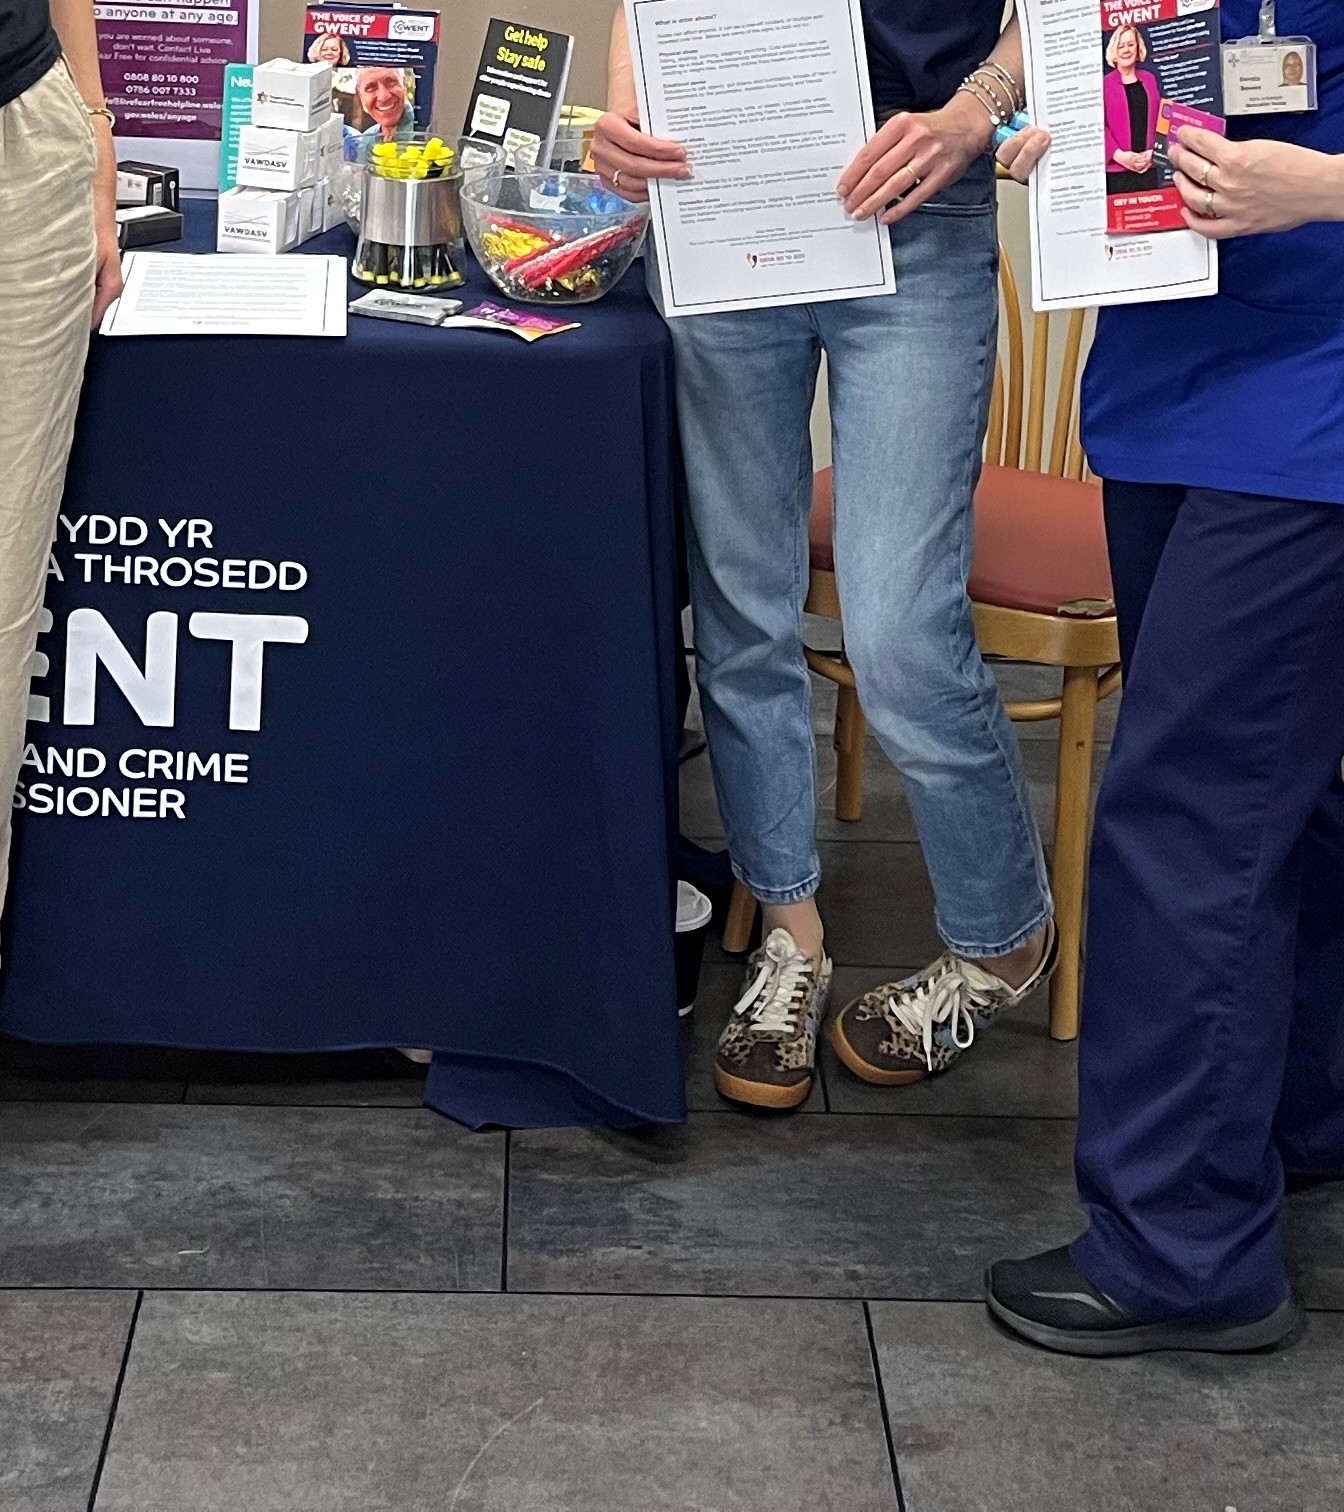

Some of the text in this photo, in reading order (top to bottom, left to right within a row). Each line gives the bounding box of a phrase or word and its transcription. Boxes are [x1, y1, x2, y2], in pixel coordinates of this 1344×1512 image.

[106, 7, 156, 21] anyone
[162, 9, 174, 19] at
[180, 11, 203, 23] any
[1104, 0, 1123, 12] THE
[1108, 4, 1161, 27] GWENT
[311, 12, 376, 23] THE VOICE OF
[314, 22, 372, 36] GWENT
[505, 26, 549, 51] Get help
[497, 47, 546, 71] Stay safe
[244, 158, 288, 168] VAWDASV
[224, 226, 268, 237] VAWDASV
[158, 518, 213, 548] YR
[74, 553, 308, 591] THROSEDD
[21, 742, 250, 784] AND CRIME
